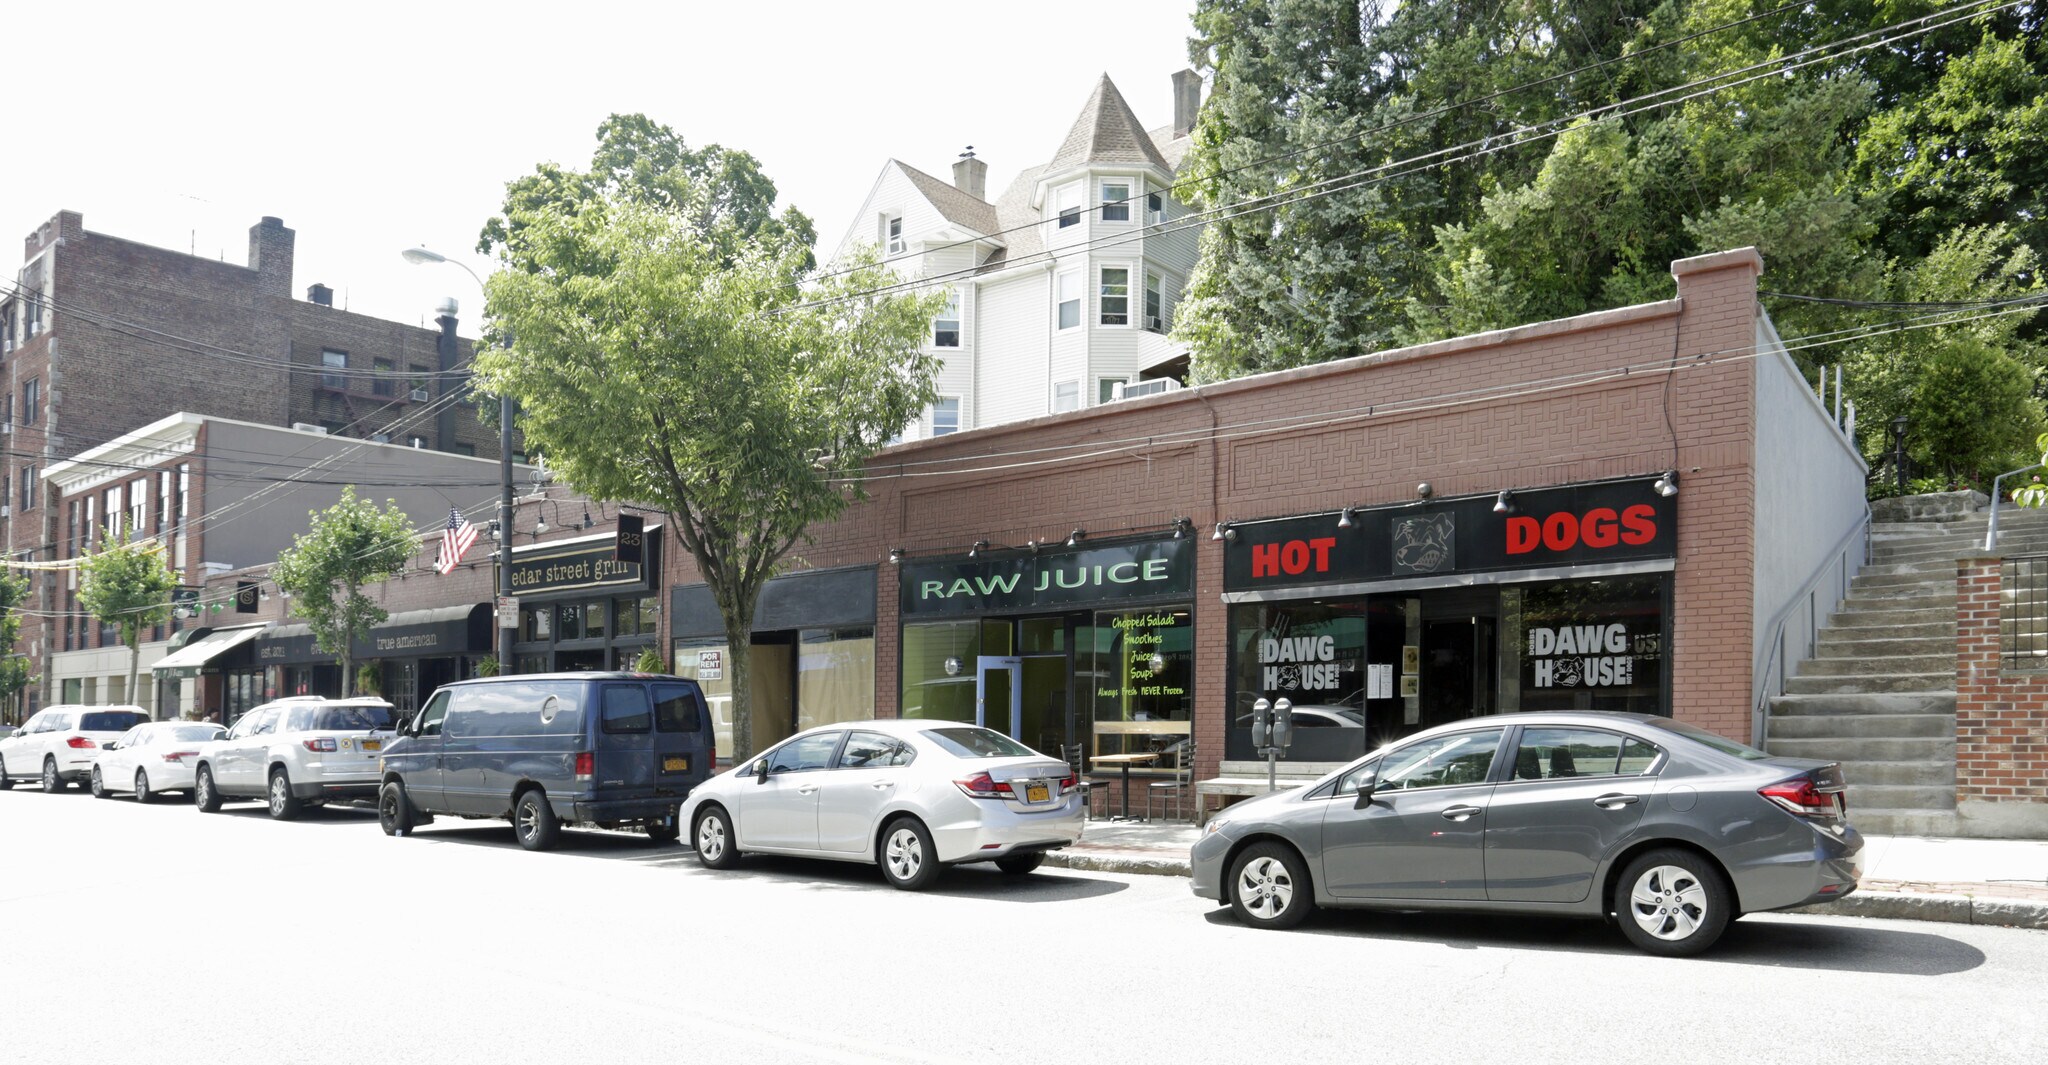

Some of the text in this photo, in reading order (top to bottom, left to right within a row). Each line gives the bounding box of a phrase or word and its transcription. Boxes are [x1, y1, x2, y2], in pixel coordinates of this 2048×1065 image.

[620, 531, 641, 547] 23
[1251, 503, 1657, 578] HOT DOGS
[512, 558, 629, 586] edar street grill
[921, 558, 1169, 600] RAW JUICE
[1112, 613, 1175, 630] Chopped Salads
[377, 633, 438, 650] true american
[1123, 632, 1163, 645] Smoothies
[1535, 623, 1627, 656] DAWG
[702, 652, 718, 661] FOR
[1130, 650, 1154, 663] Juices
[1263, 635, 1335, 663] DAWG
[700, 660, 720, 669] RENT
[1534, 656, 1627, 688] HUSE
[1130, 667, 1153, 680] Soups
[1263, 663, 1335, 691] HUSE
[1097, 685, 1184, 698] Always Fresh NEVER Frozen
